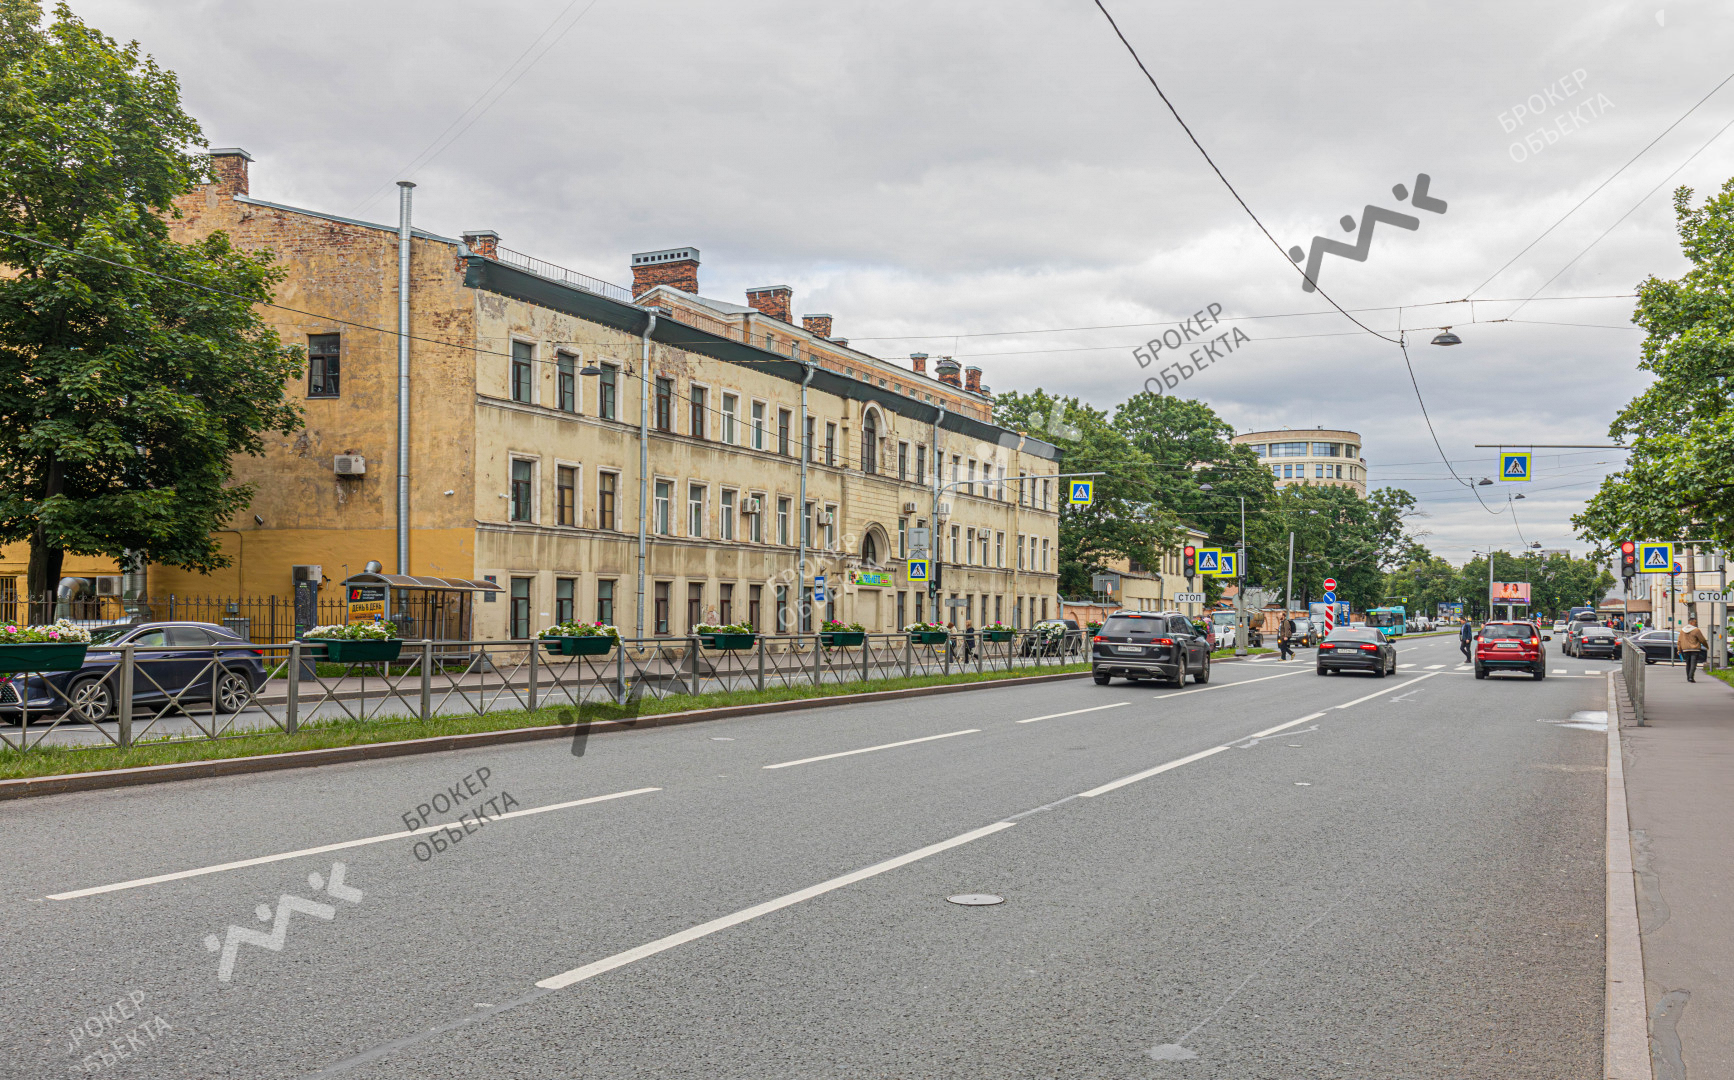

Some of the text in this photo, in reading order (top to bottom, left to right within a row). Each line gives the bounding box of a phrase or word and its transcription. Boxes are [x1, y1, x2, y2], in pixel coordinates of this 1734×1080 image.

[1178, 594, 1202, 602] СТОП
[1698, 592, 1728, 601] СТОП
[352, 603, 365, 612] ДЕНЬ
[370, 602, 382, 611] ДЕНЬ
